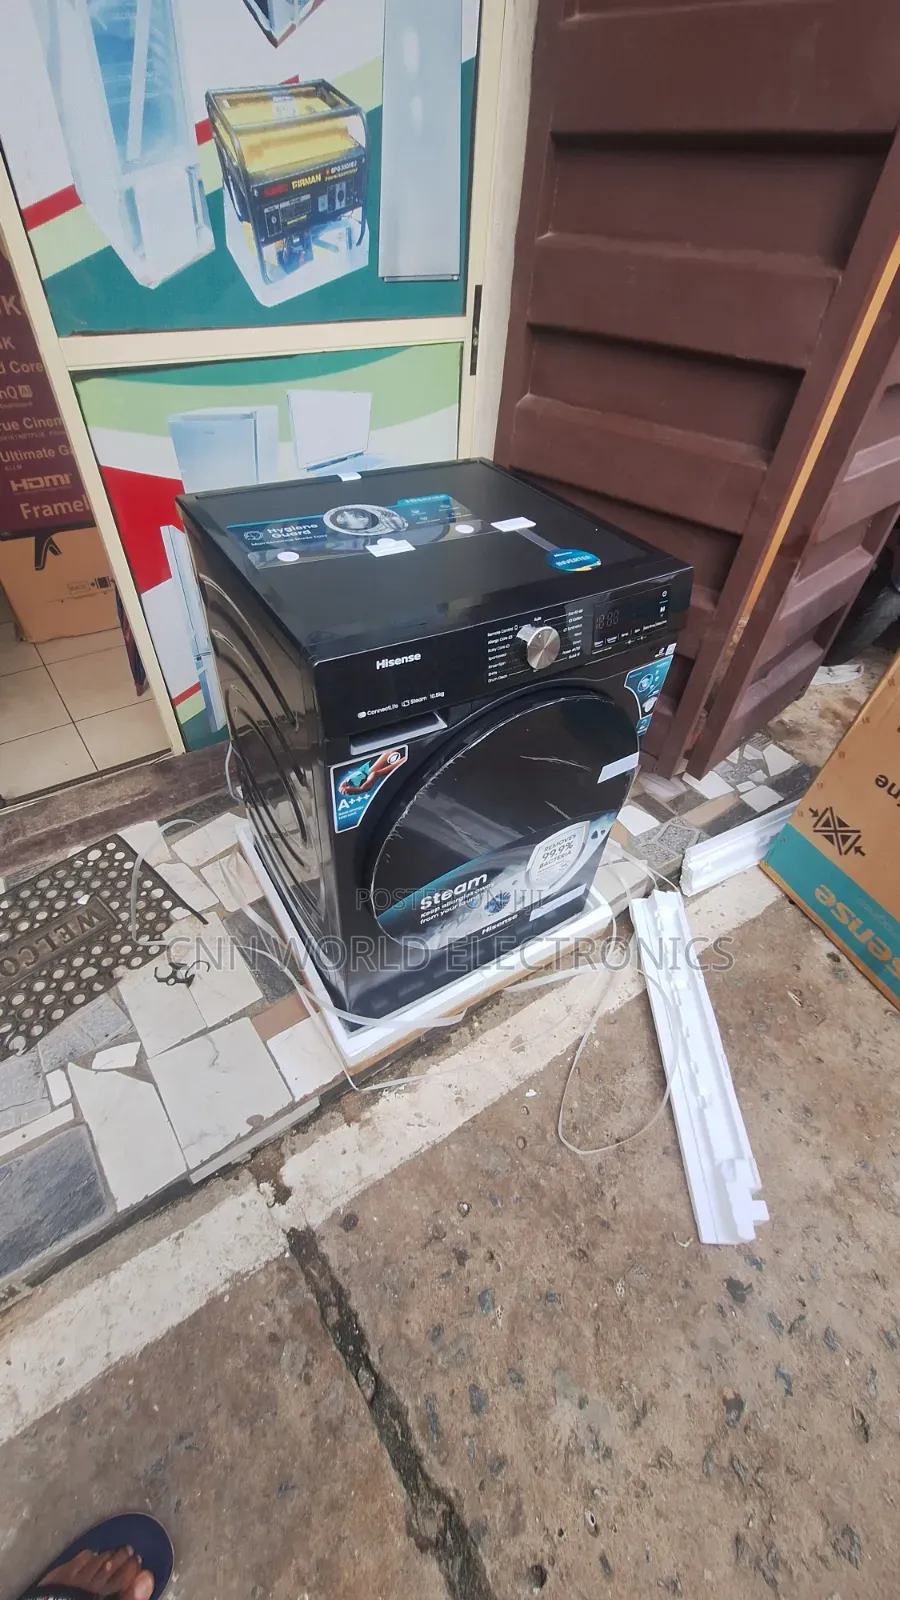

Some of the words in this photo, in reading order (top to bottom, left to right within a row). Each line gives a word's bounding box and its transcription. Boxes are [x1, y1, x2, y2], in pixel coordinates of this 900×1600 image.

[291, 173, 322, 190] FIRMAN
[9, 360, 44, 374] Core
[0, 447, 56, 463] Ultimate
[9, 473, 72, 492] HDMI
[266, 523, 319, 534] Hygiene
[271, 529, 312, 539] Guard
[375, 652, 422, 670] Hisense
[366, 703, 399, 716] ConnectLife
[410, 696, 428, 705] Steam
[337, 793, 371, 811] A+++
[420, 873, 488, 911] Steam
[419, 912, 440, 925] from
[439, 904, 459, 917] your
[420, 905, 441, 919] Keep
[481, 913, 519, 934] Hisense
